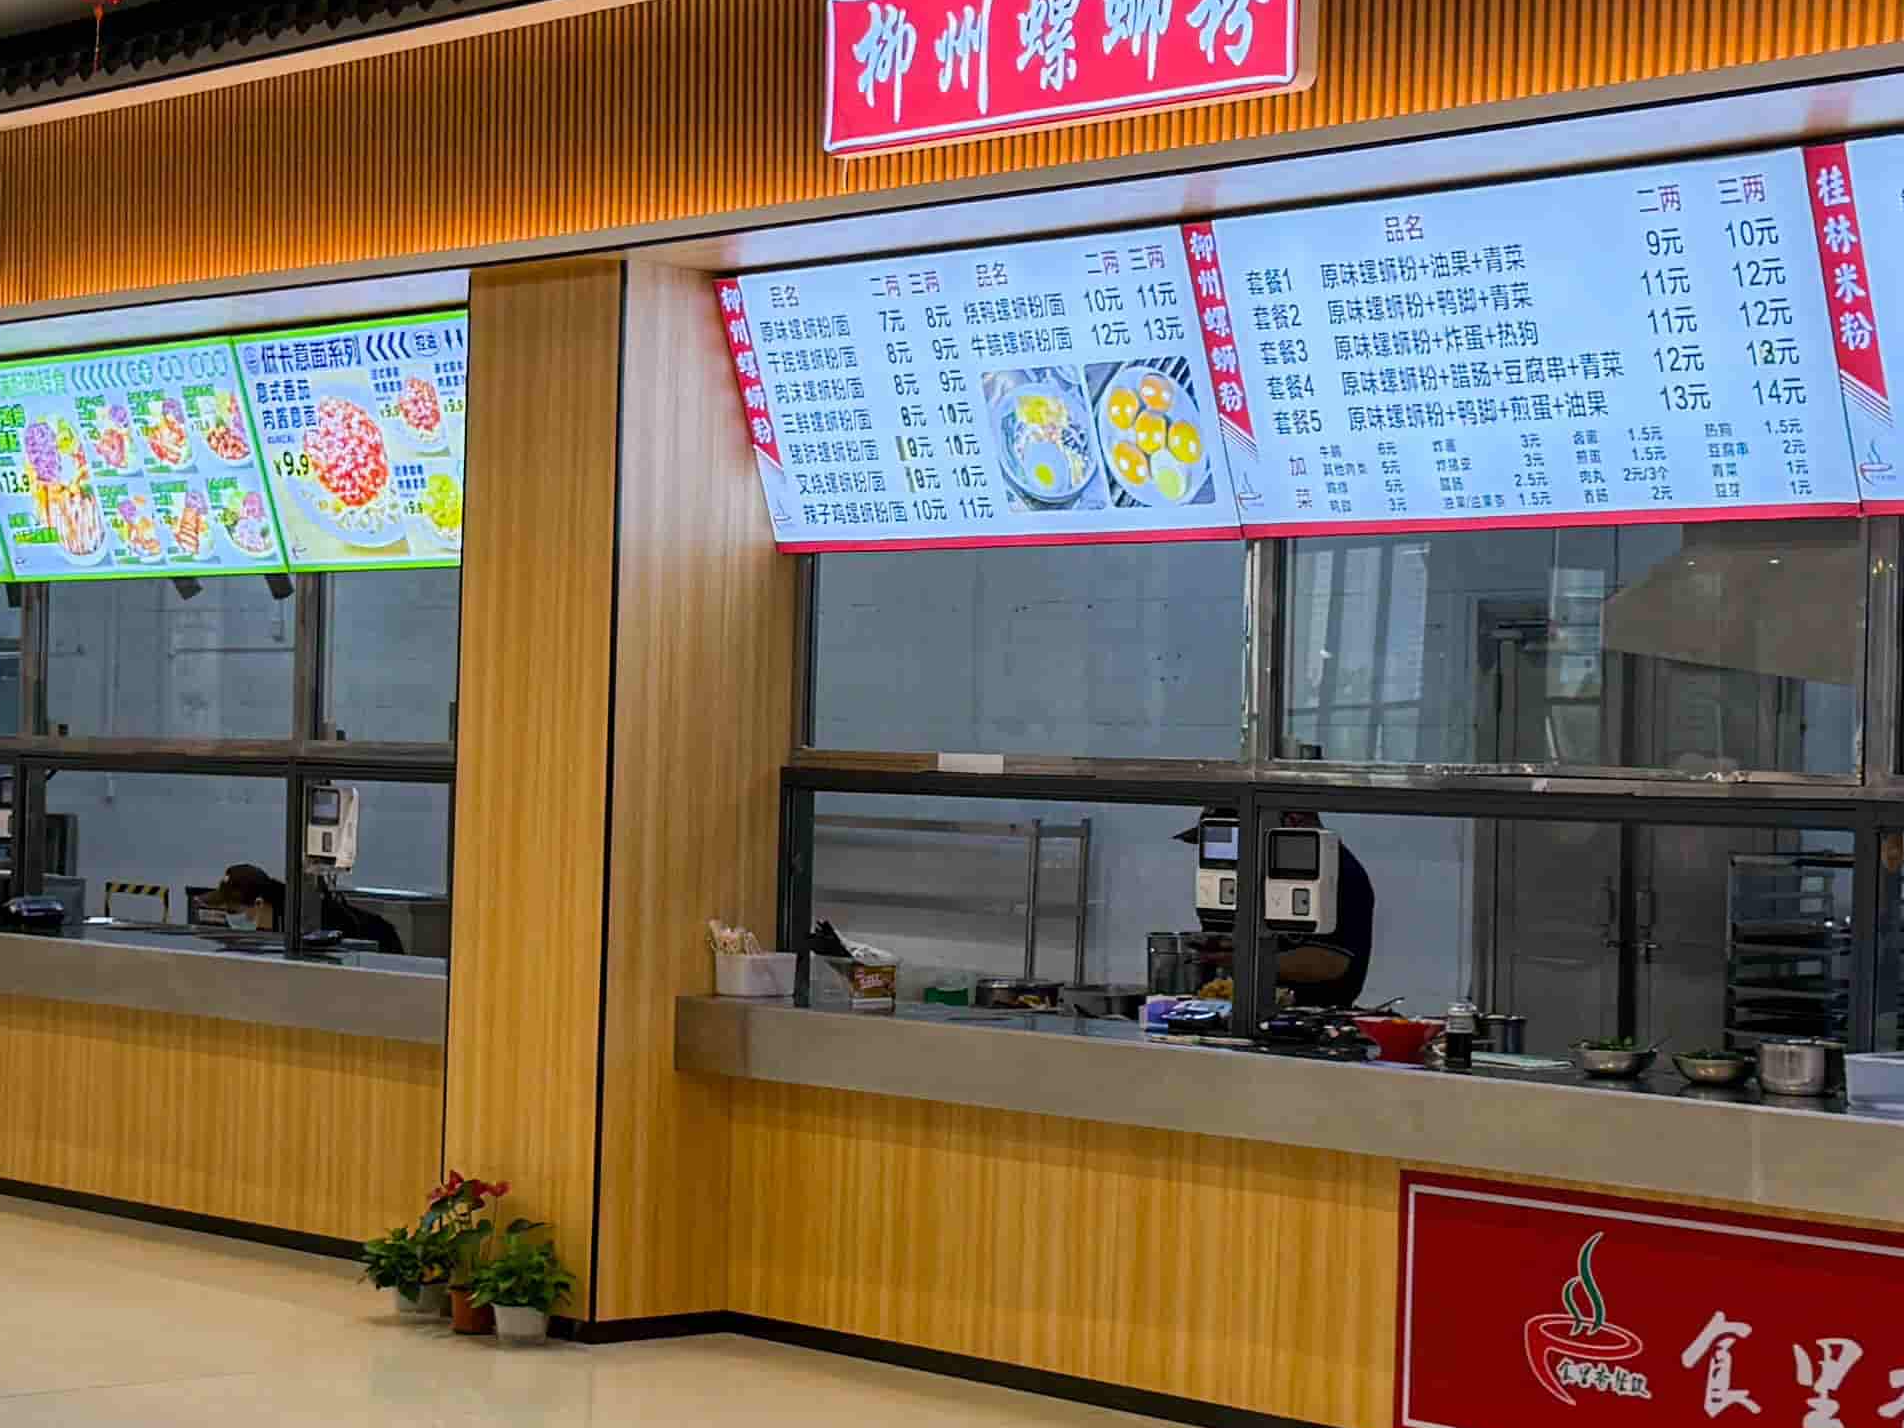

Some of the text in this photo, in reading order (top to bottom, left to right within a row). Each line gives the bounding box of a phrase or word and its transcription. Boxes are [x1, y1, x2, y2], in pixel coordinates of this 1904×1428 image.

[1385, 174, 1767, 242] 品名 二两 三两
[1247, 268, 1292, 295] 套餐1
[1646, 228, 1684, 256] 9元
[1725, 217, 1779, 249] 10元
[1816, 165, 1873, 351] 桂林米粉
[878, 309, 905, 332] 7元
[925, 305, 951, 328] 8元
[1084, 287, 1123, 312] 10元
[1136, 282, 1176, 308] 11元
[1253, 304, 1302, 330] 套餐2
[1641, 267, 1690, 296] 11元
[1732, 258, 1786, 288] 12元
[886, 342, 912, 364] 8元
[932, 338, 958, 361] 9元
[1091, 321, 1130, 346] 12元
[1144, 317, 1184, 340] 13元
[1260, 338, 1308, 365] 套餐3
[1648, 306, 1697, 335] 11元
[1740, 297, 1792, 327] 12元
[1267, 374, 1315, 400] 套餐4
[1654, 345, 1704, 372] 12元
[1274, 409, 1322, 436] 套餐5
[1660, 383, 1711, 411] 13元
[1752, 377, 1806, 406] 14元
